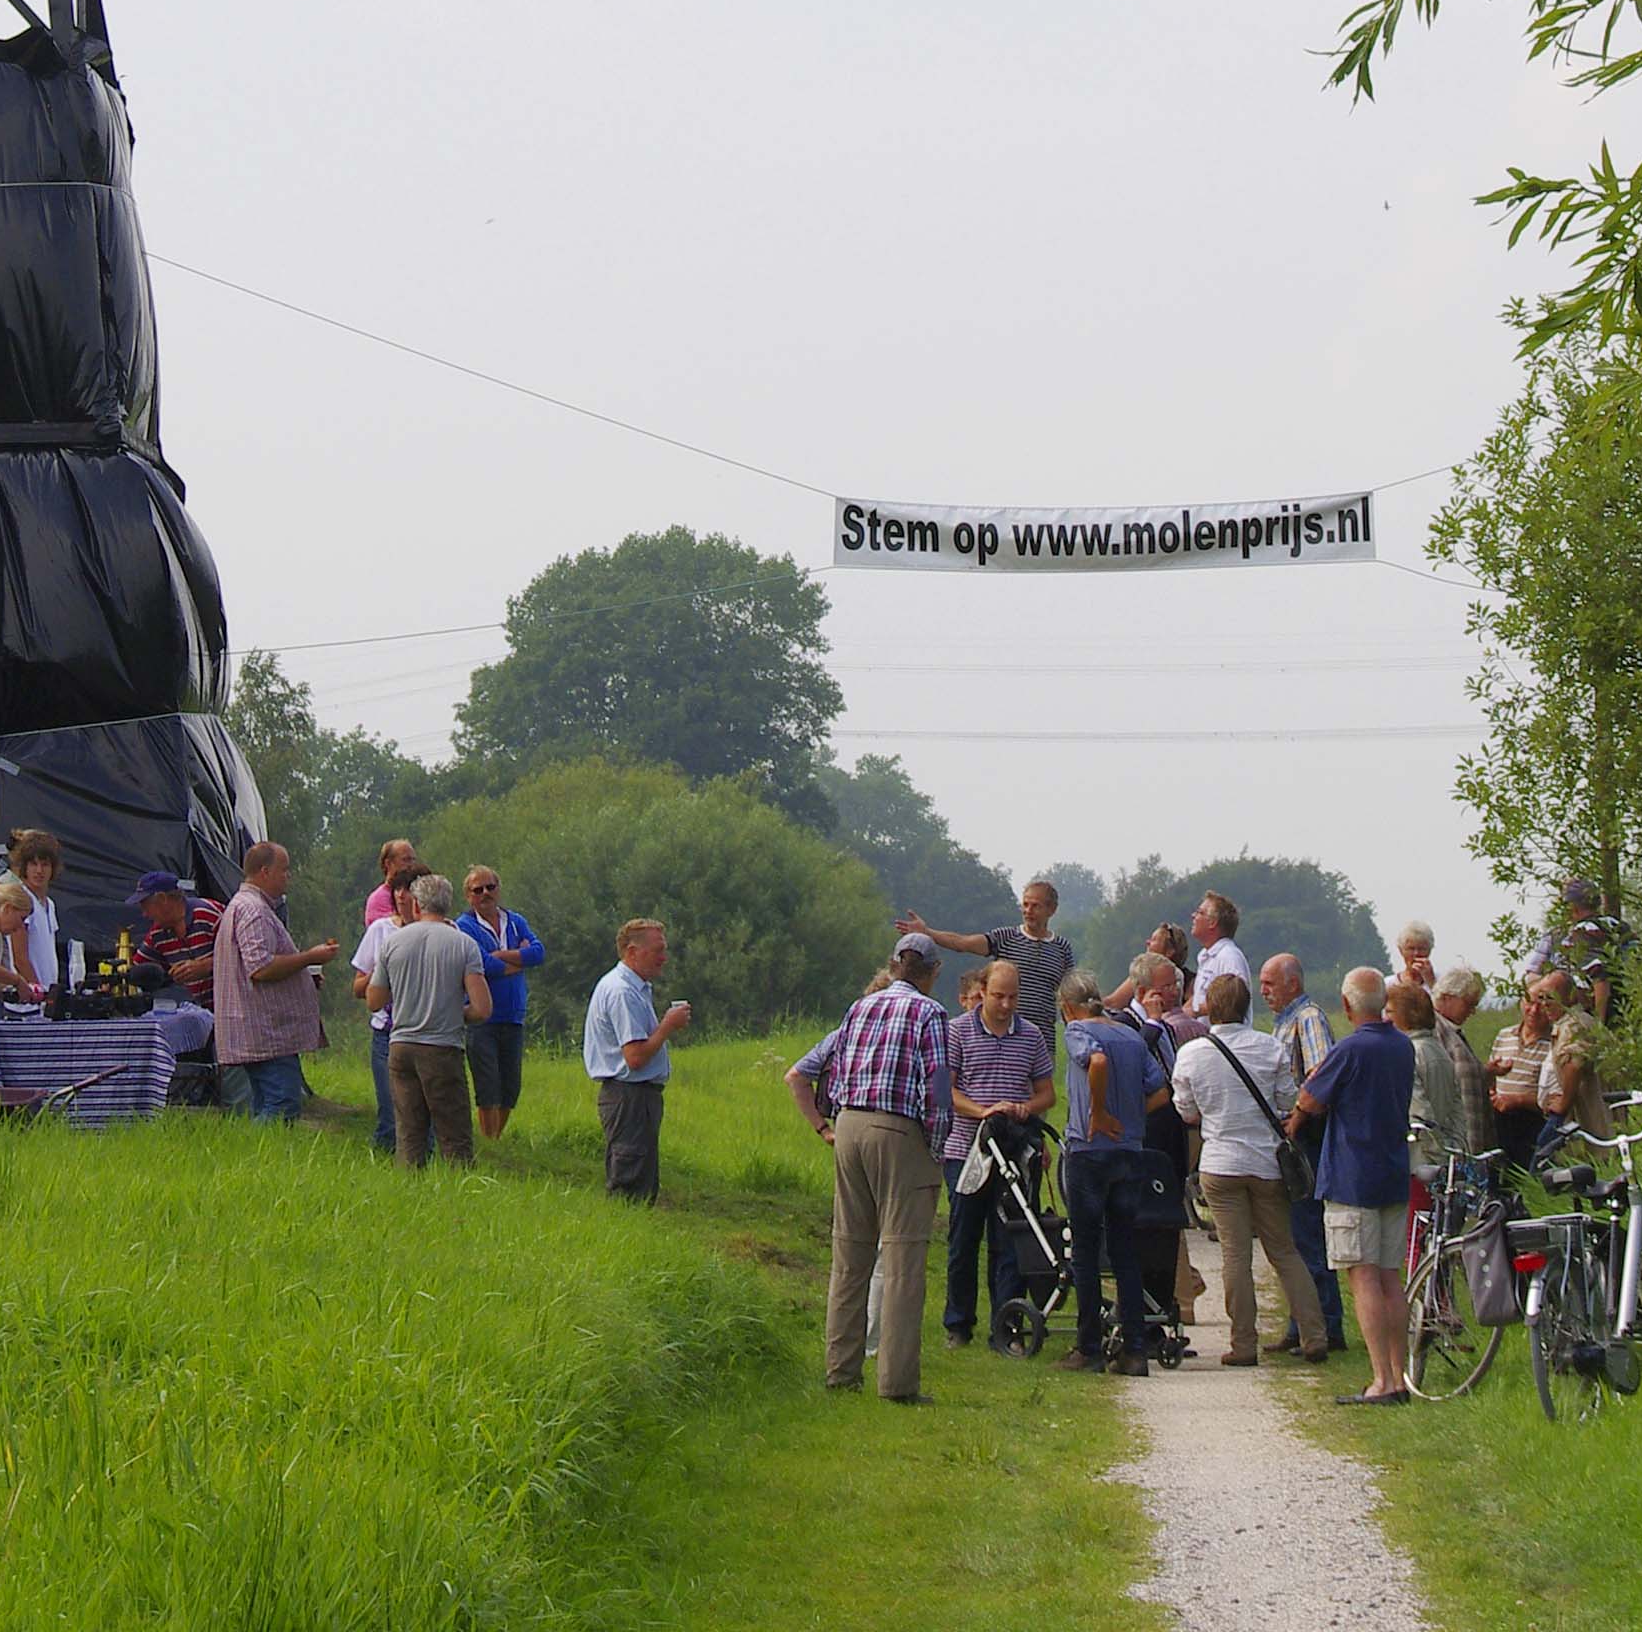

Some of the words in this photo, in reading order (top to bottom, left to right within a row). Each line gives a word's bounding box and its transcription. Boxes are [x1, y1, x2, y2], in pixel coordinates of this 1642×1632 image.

[841, 504, 939, 552] Stem
[953, 522, 999, 565] op
[1012, 496, 1370, 558] www.molenprijs.nl
